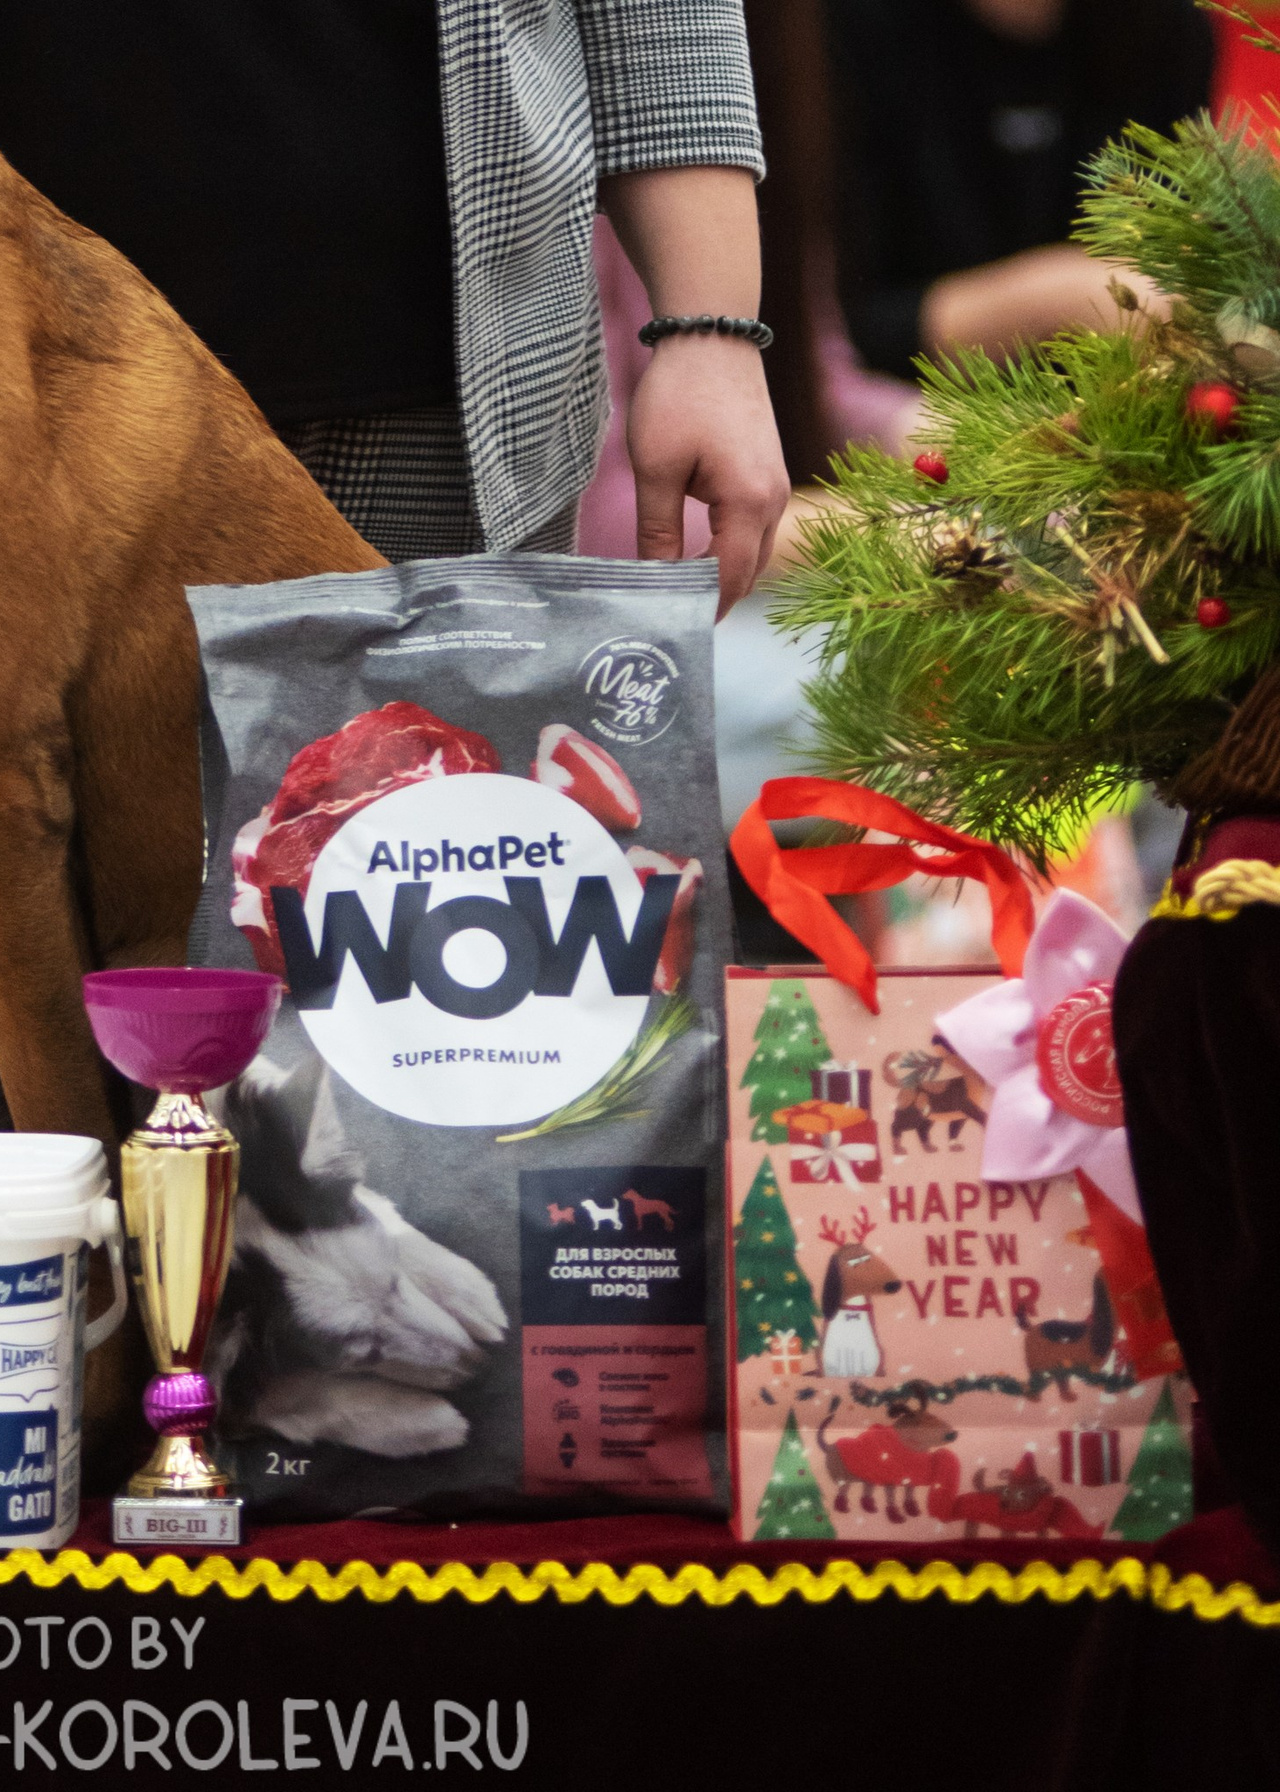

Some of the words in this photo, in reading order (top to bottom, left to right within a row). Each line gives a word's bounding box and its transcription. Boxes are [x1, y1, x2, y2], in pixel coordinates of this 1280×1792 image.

[439, 630, 512, 641] СООТВЕТСТВИЕ
[585, 655, 670, 705] Meat
[614, 700, 658, 726] 76%
[616, 734, 641, 743] MEAT
[367, 832, 566, 881] AlphaPet
[270, 874, 681, 1020] WOW
[392, 1047, 561, 1068] SUPERPREMIUM
[889, 1182, 1050, 1223] HAPPY
[556, 1248, 589, 1263] ДЛЯ
[593, 1248, 677, 1261] ВЗРОСЛЫХ
[926, 1229, 1018, 1267] NEW
[549, 1266, 605, 1279] СОБАК
[607, 1266, 681, 1281] СРЕДНИХ
[591, 1284, 649, 1299] ПОРОД
[906, 1275, 1041, 1319] YEAR
[1, 1348, 45, 1374] HAPPY
[24, 1426, 47, 1455] MI
[145, 1518, 208, 1534] BIG-III
